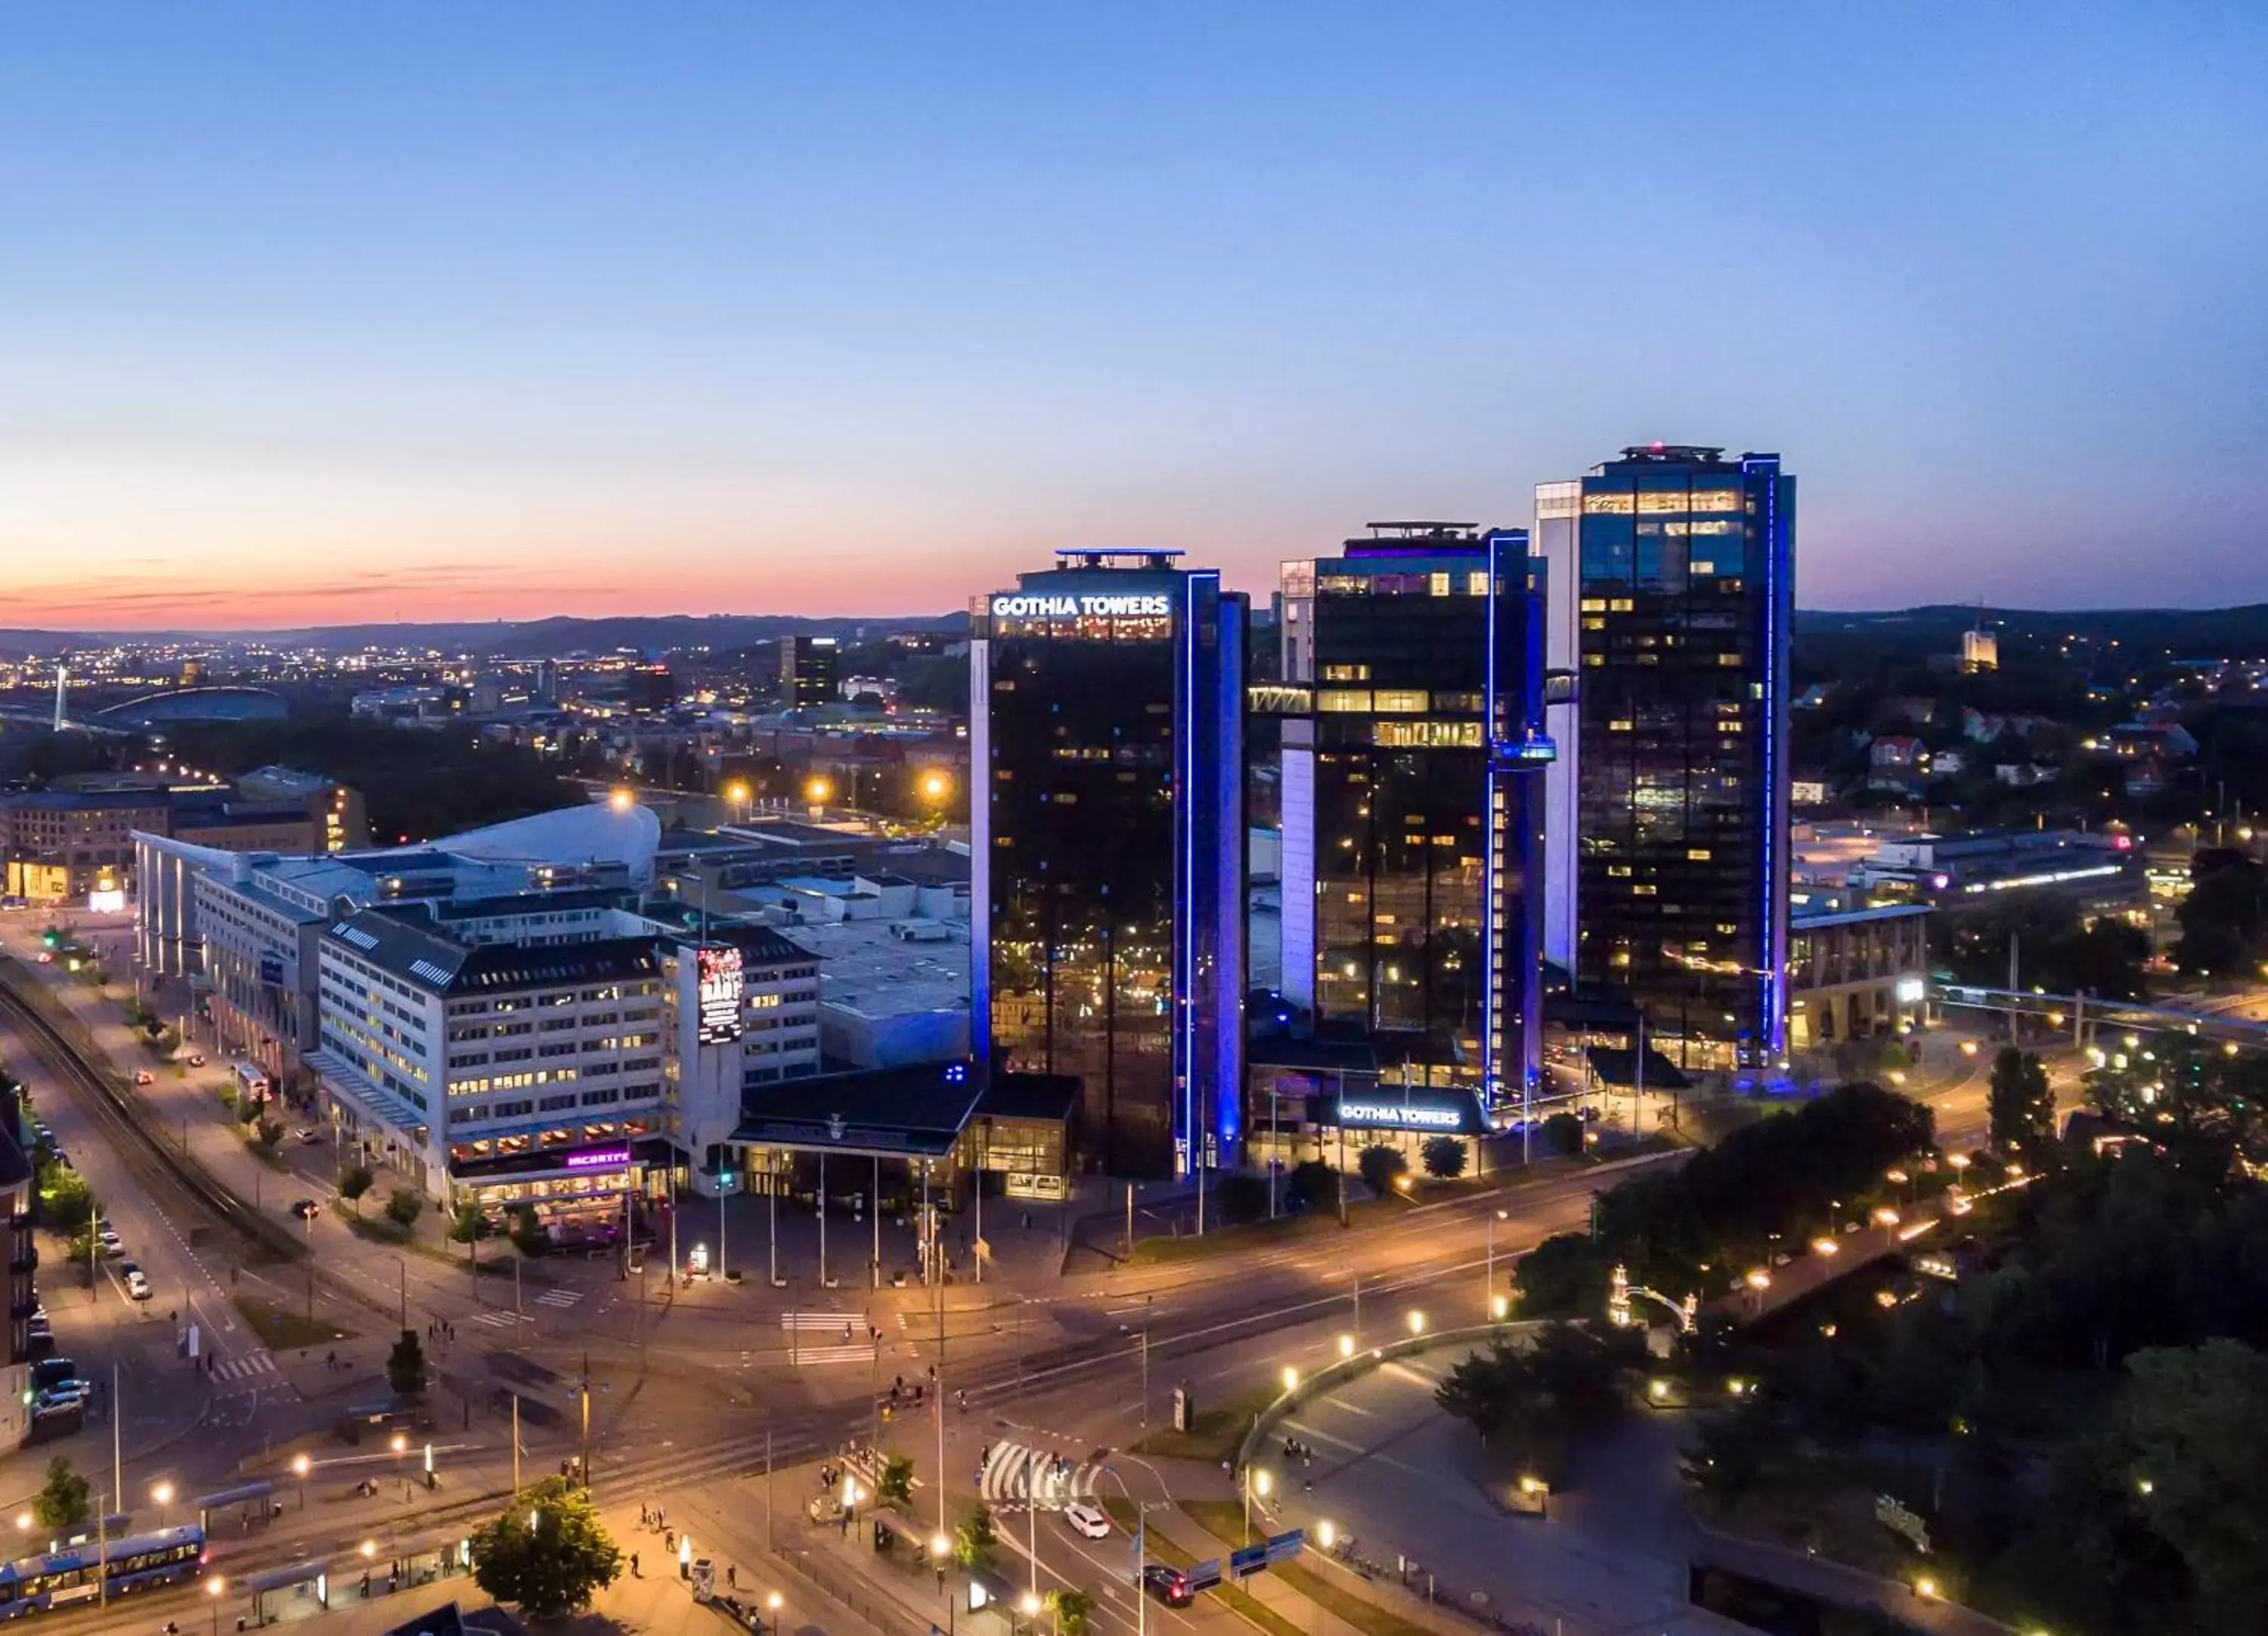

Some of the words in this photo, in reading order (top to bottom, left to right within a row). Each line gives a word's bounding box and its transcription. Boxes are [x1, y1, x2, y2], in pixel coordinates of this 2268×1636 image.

[993, 596, 1077, 616] GOTHIA
[1080, 596, 1168, 615] TOWERS
[1340, 1105, 1399, 1122] GOTHIA
[1399, 1109, 1461, 1126] TOWERS
